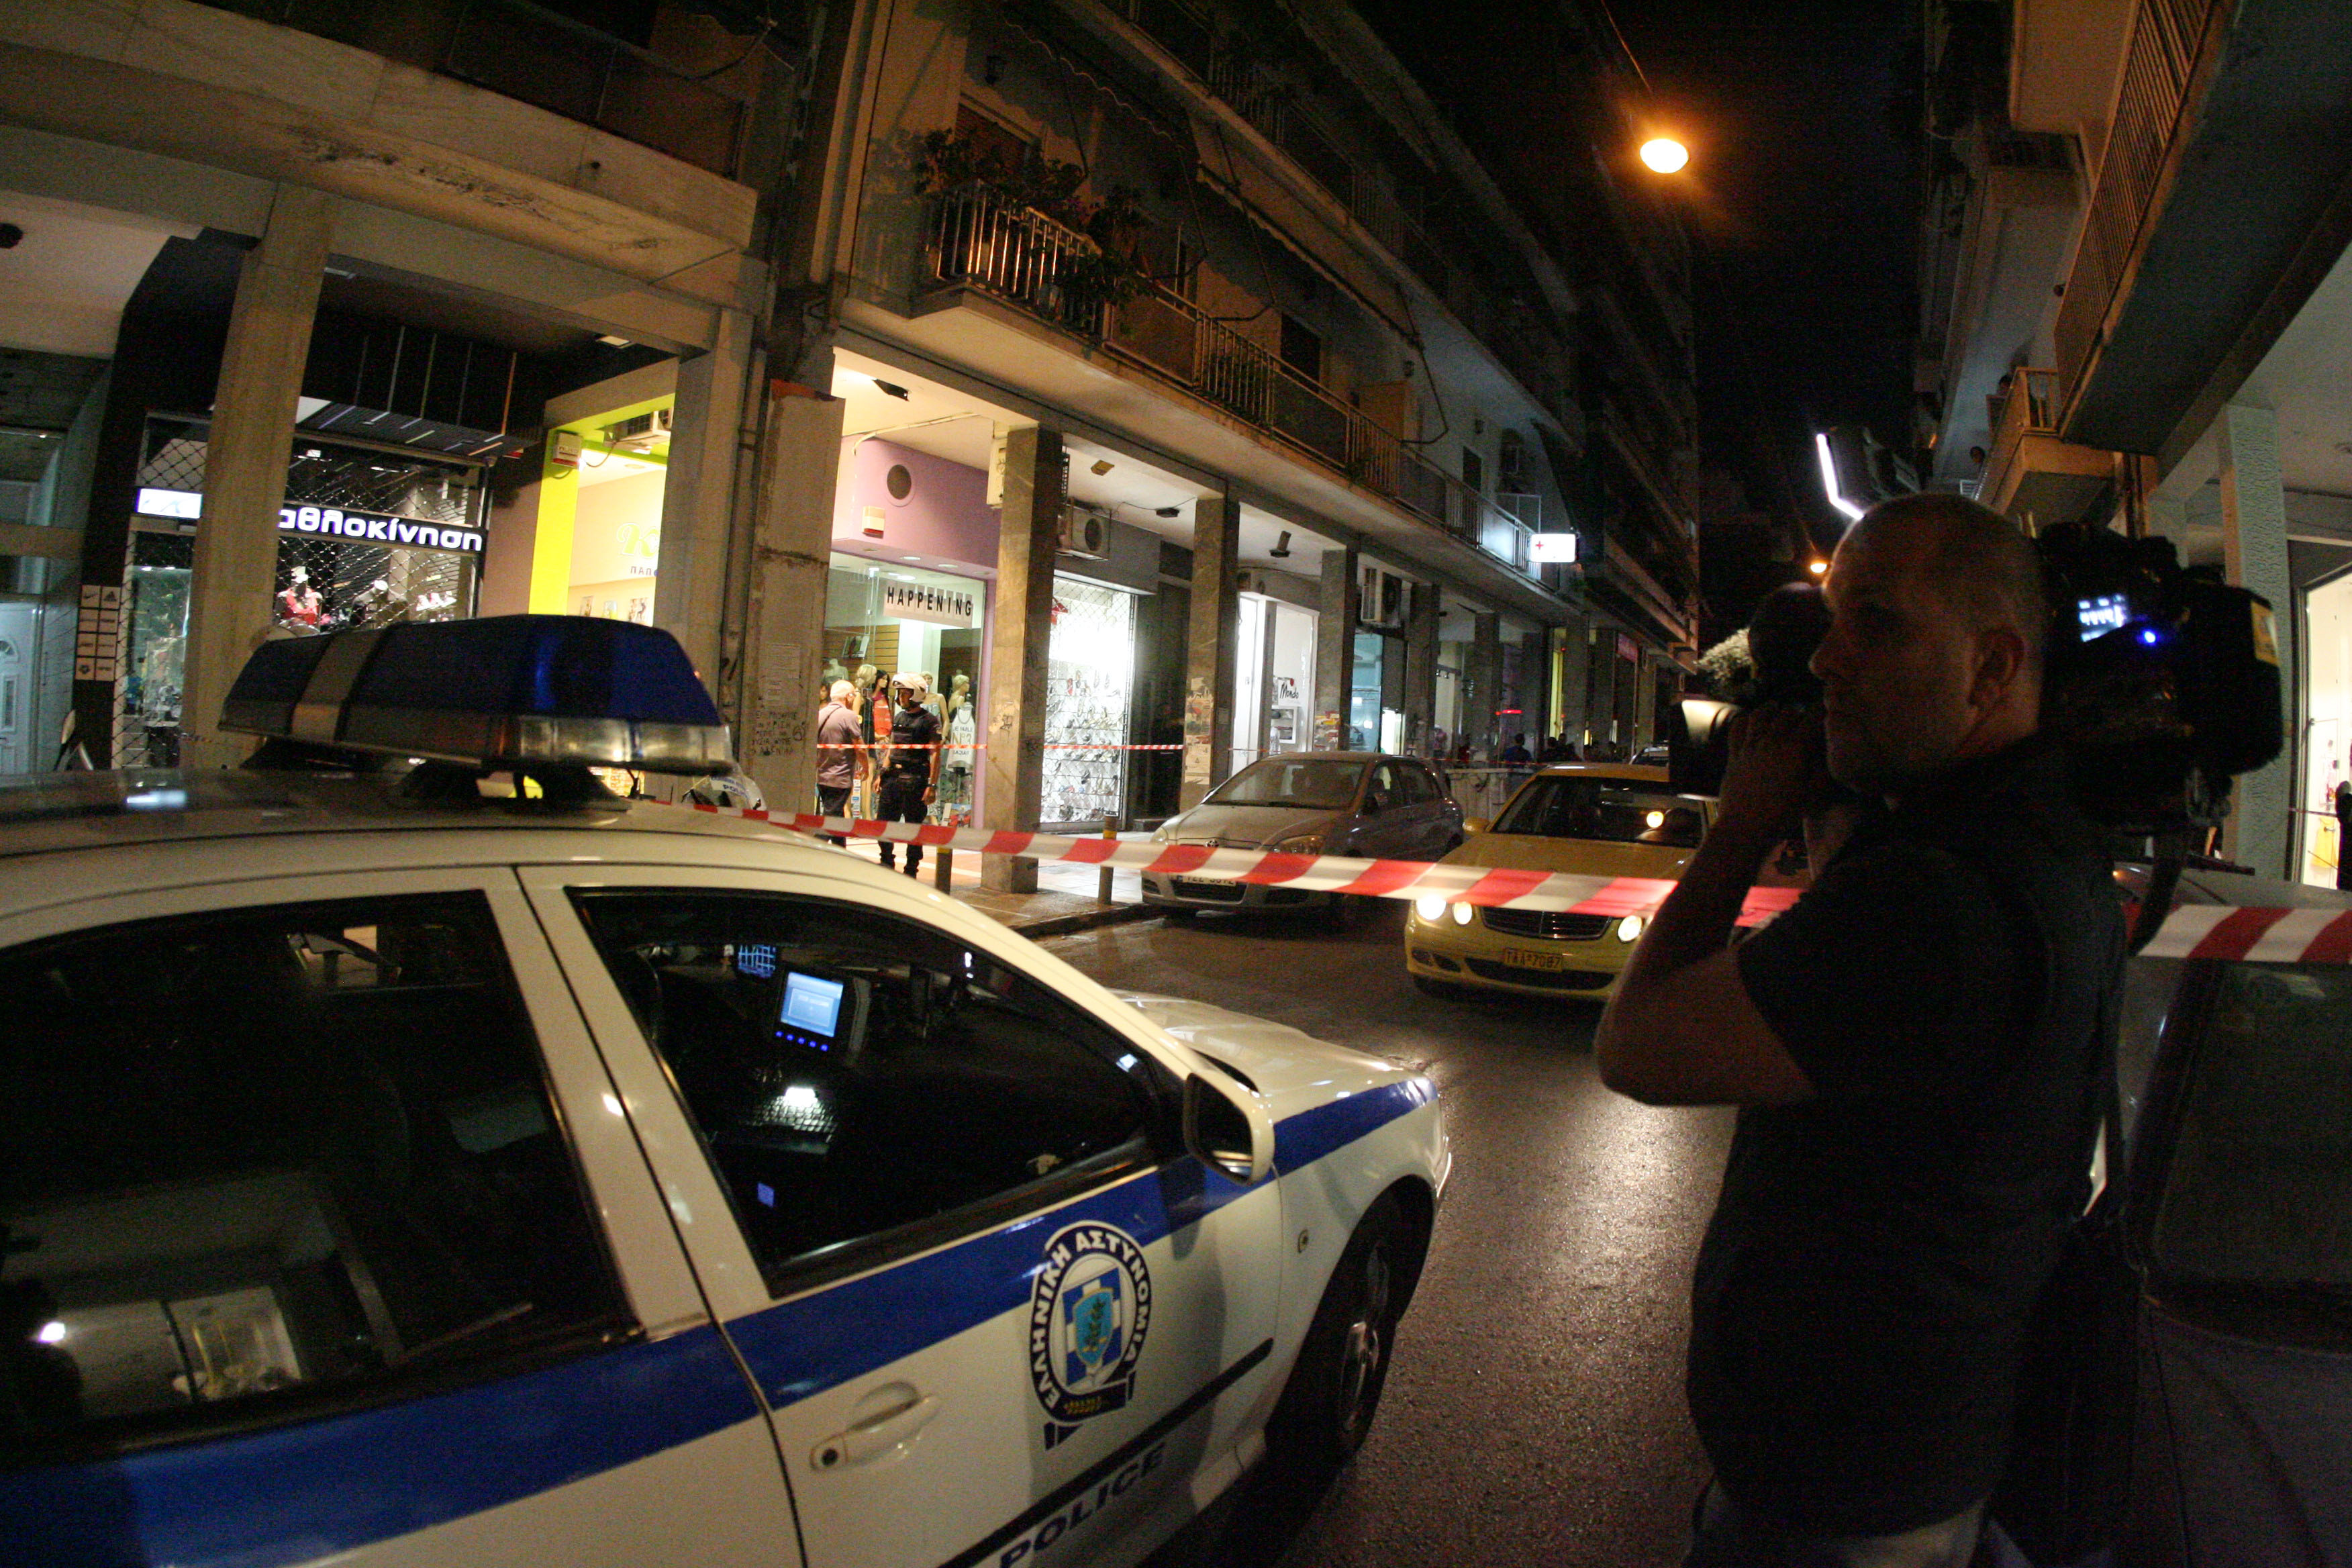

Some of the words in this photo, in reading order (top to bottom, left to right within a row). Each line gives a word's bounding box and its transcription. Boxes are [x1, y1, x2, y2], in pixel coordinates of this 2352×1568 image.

[887, 586, 973, 617] HAPPENING
[1279, 683, 1299, 699] Mondo
[1032, 1242, 1073, 1410] ΕΛΛΗΝΙΚΗ
[1075, 1230, 1150, 1362] ΑΣΤΥΝΟΜΙΑ
[1000, 1442, 1166, 1568] POLICE
